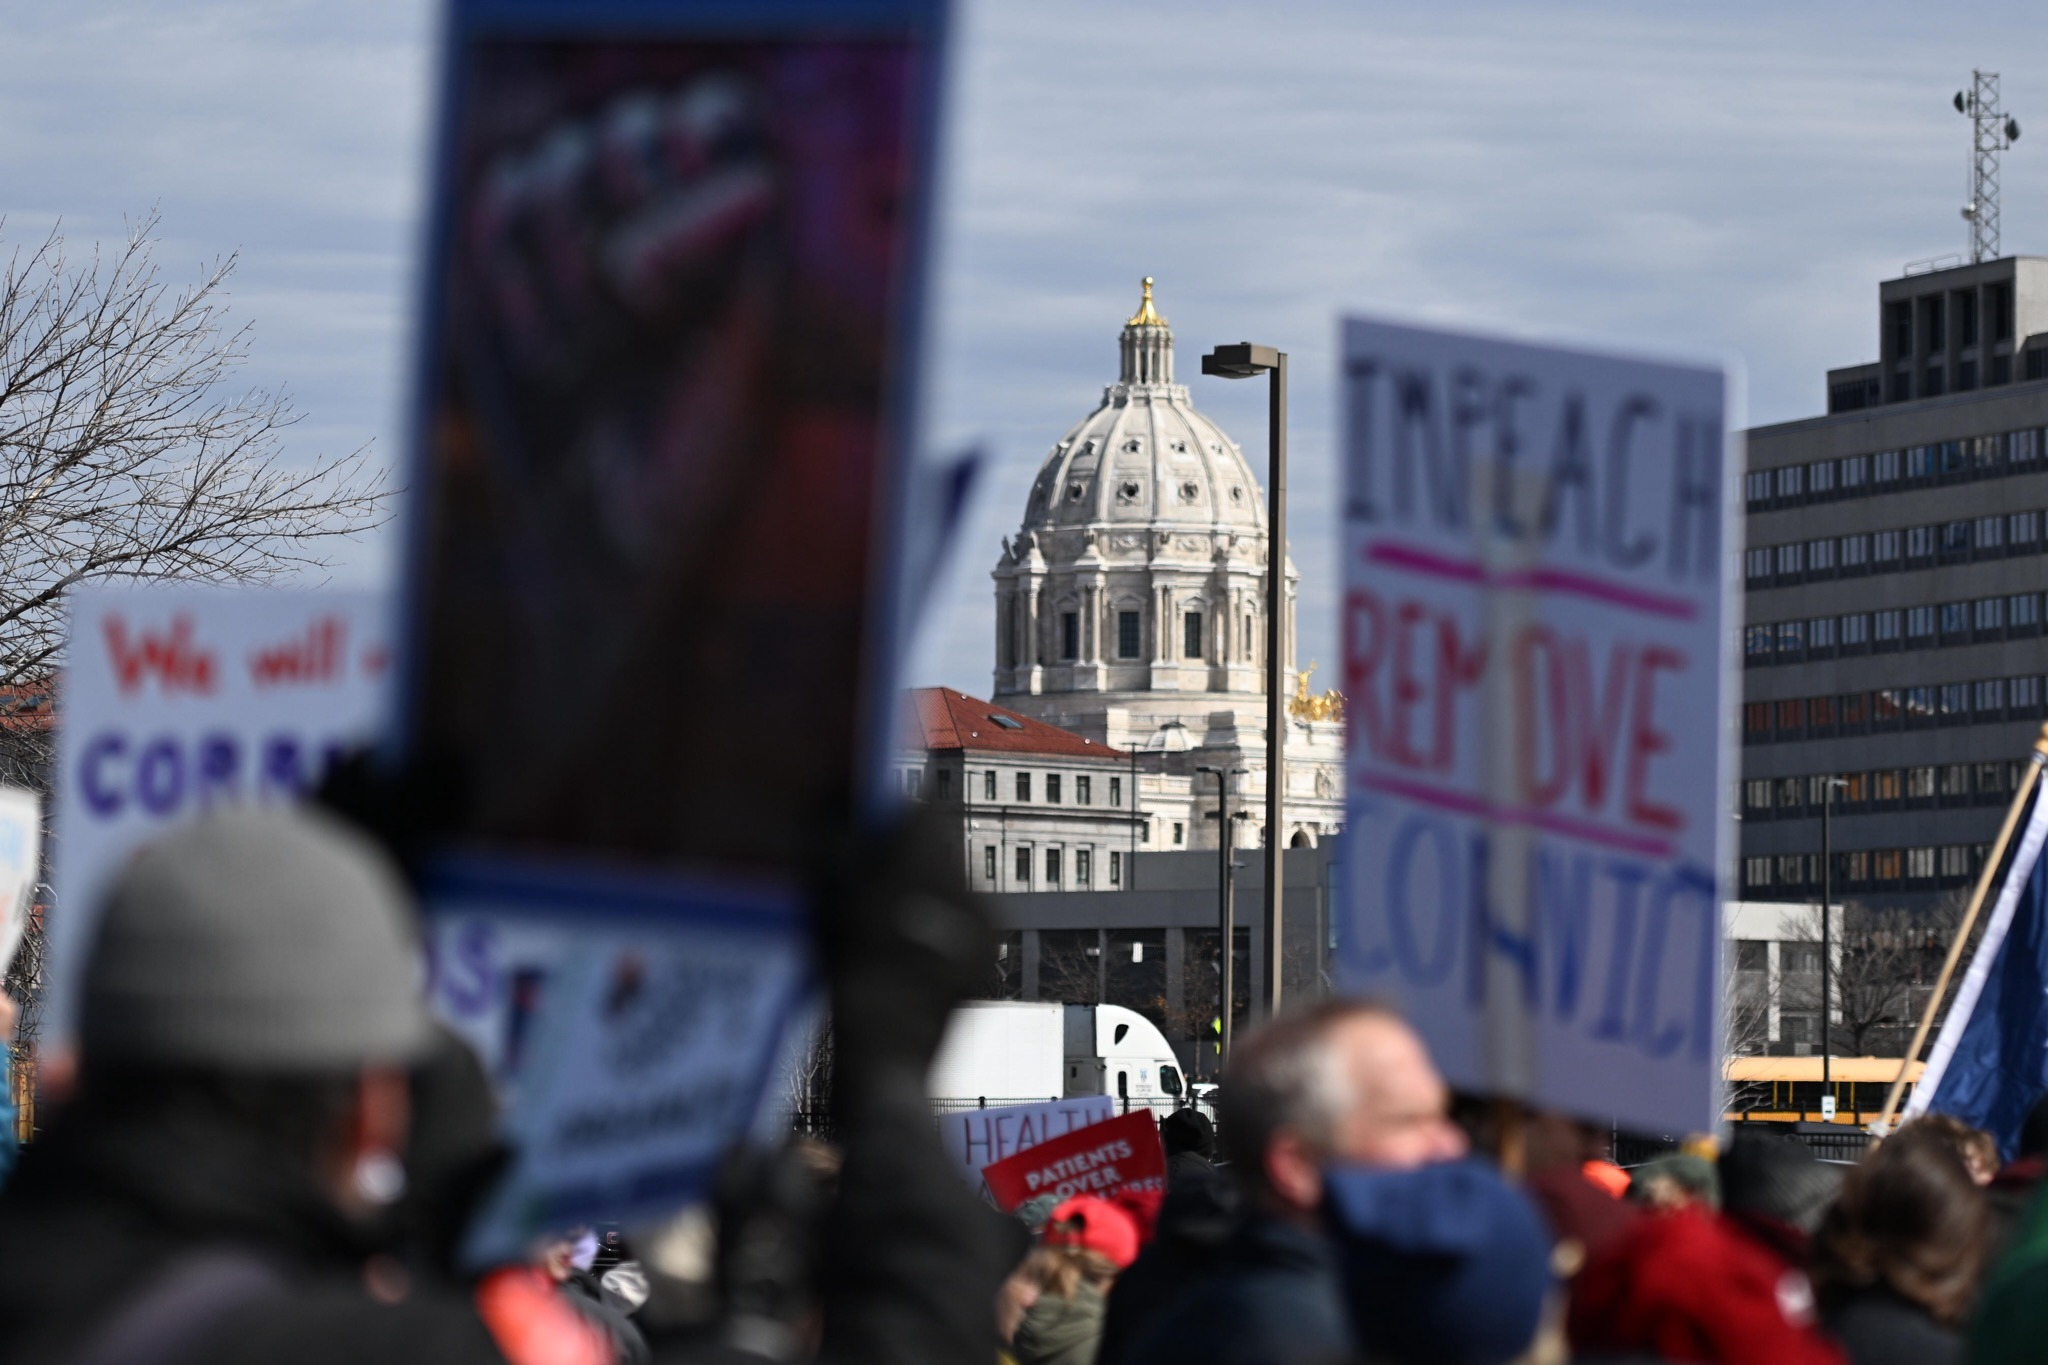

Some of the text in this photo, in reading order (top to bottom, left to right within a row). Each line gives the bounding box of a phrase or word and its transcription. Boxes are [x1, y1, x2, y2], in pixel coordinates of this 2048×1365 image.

[1345, 356, 1724, 580] IMPEACH
[103, 612, 217, 696] We
[250, 615, 348, 686] will
[1025, 1139, 1133, 1191] PATIENTS
[1055, 1166, 1122, 1198] OVER
